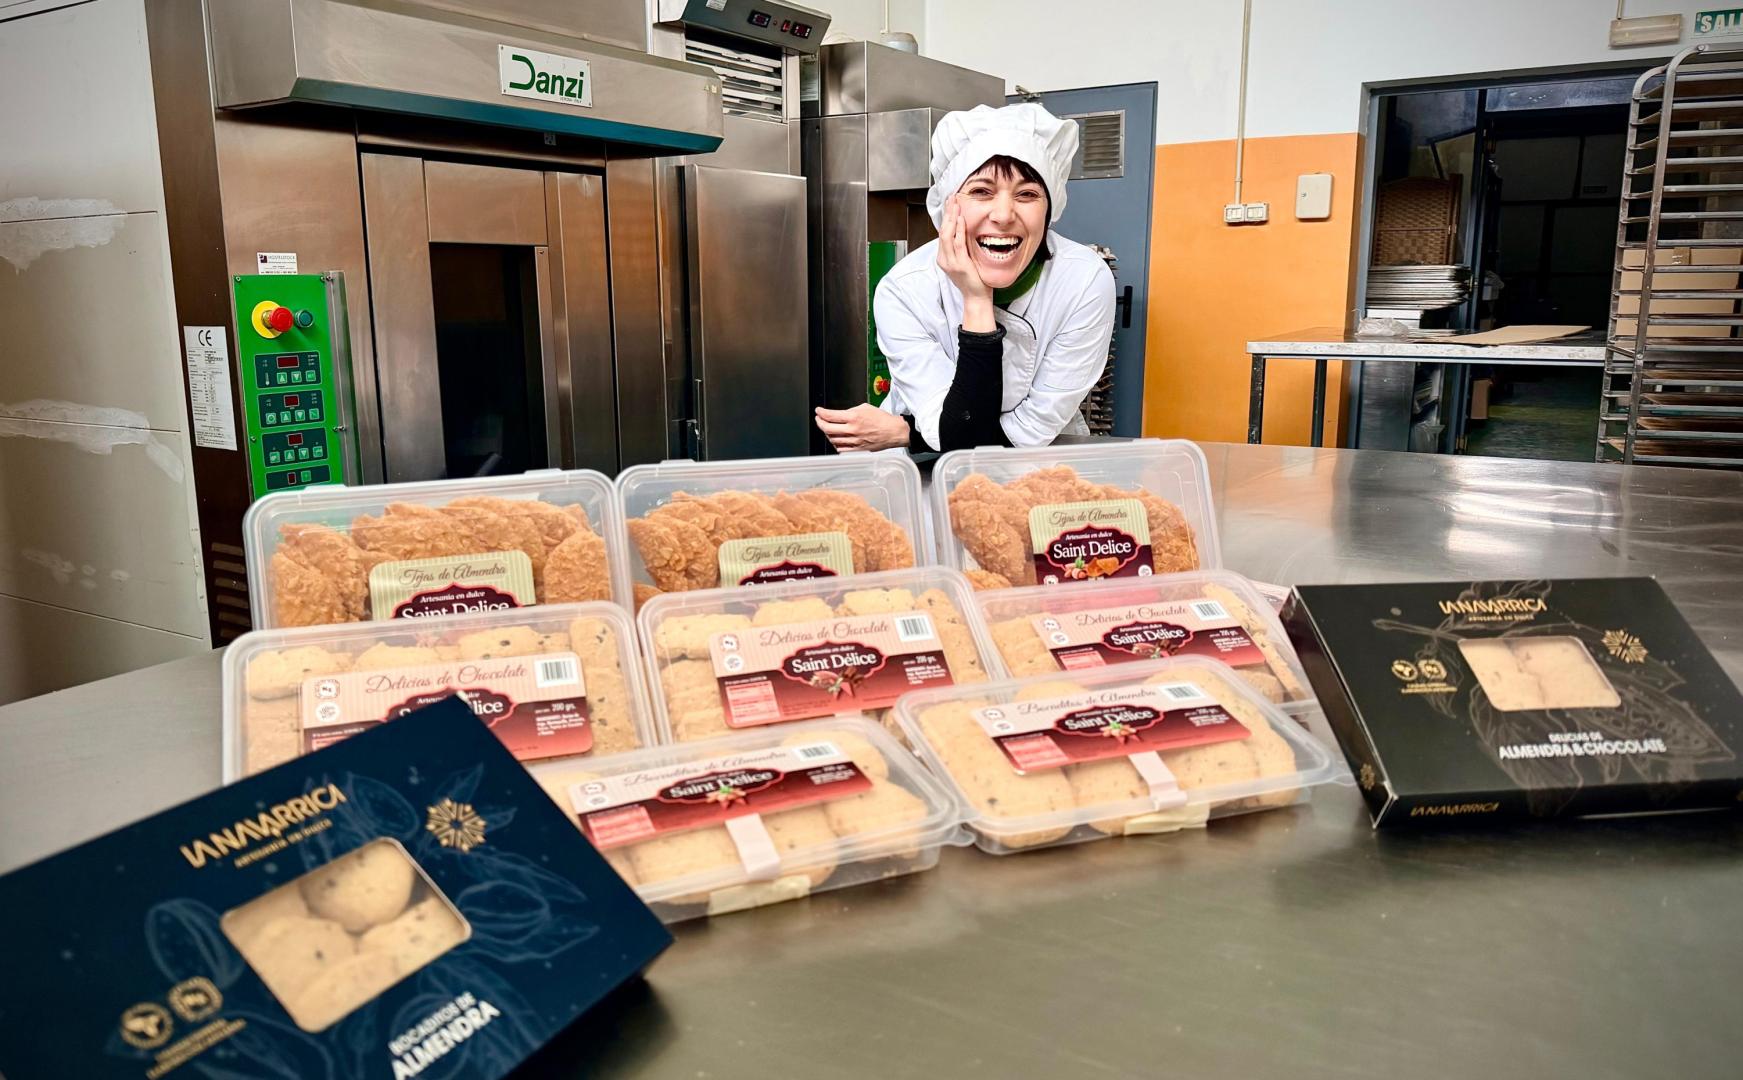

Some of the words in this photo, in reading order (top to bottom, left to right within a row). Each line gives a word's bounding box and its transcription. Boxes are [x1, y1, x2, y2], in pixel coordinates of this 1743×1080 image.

[509, 54, 584, 99] Danzi
[1049, 511, 1075, 526] Tejas
[1077, 511, 1087, 521] de
[1088, 507, 1128, 521] Almendra
[742, 546, 771, 562] Tejas
[773, 546, 784, 558] de
[785, 542, 831, 557] Almendra
[1053, 540, 1087, 559] Saint
[1089, 539, 1132, 556] Delice
[399, 569, 434, 587] Tejas
[438, 568, 450, 580] de
[453, 563, 506, 580] Almendra
[466, 590, 485, 598] dulce
[1125, 610, 1135, 620] de
[817, 627, 829, 639] de
[833, 621, 889, 639] Chocolate
[1111, 633, 1143, 645] Saint
[792, 657, 829, 674] Saint
[365, 675, 431, 693] Delicias
[437, 671, 452, 685] de
[458, 664, 527, 684] Chocolate
[473, 700, 504, 715] lice
[1086, 696, 1096, 705] de
[1065, 715, 1104, 730] Saint
[705, 762, 716, 770] de
[670, 783, 715, 798] Saint
[455, 991, 477, 1010] DE
[392, 1000, 501, 1080] ALMENDRA
